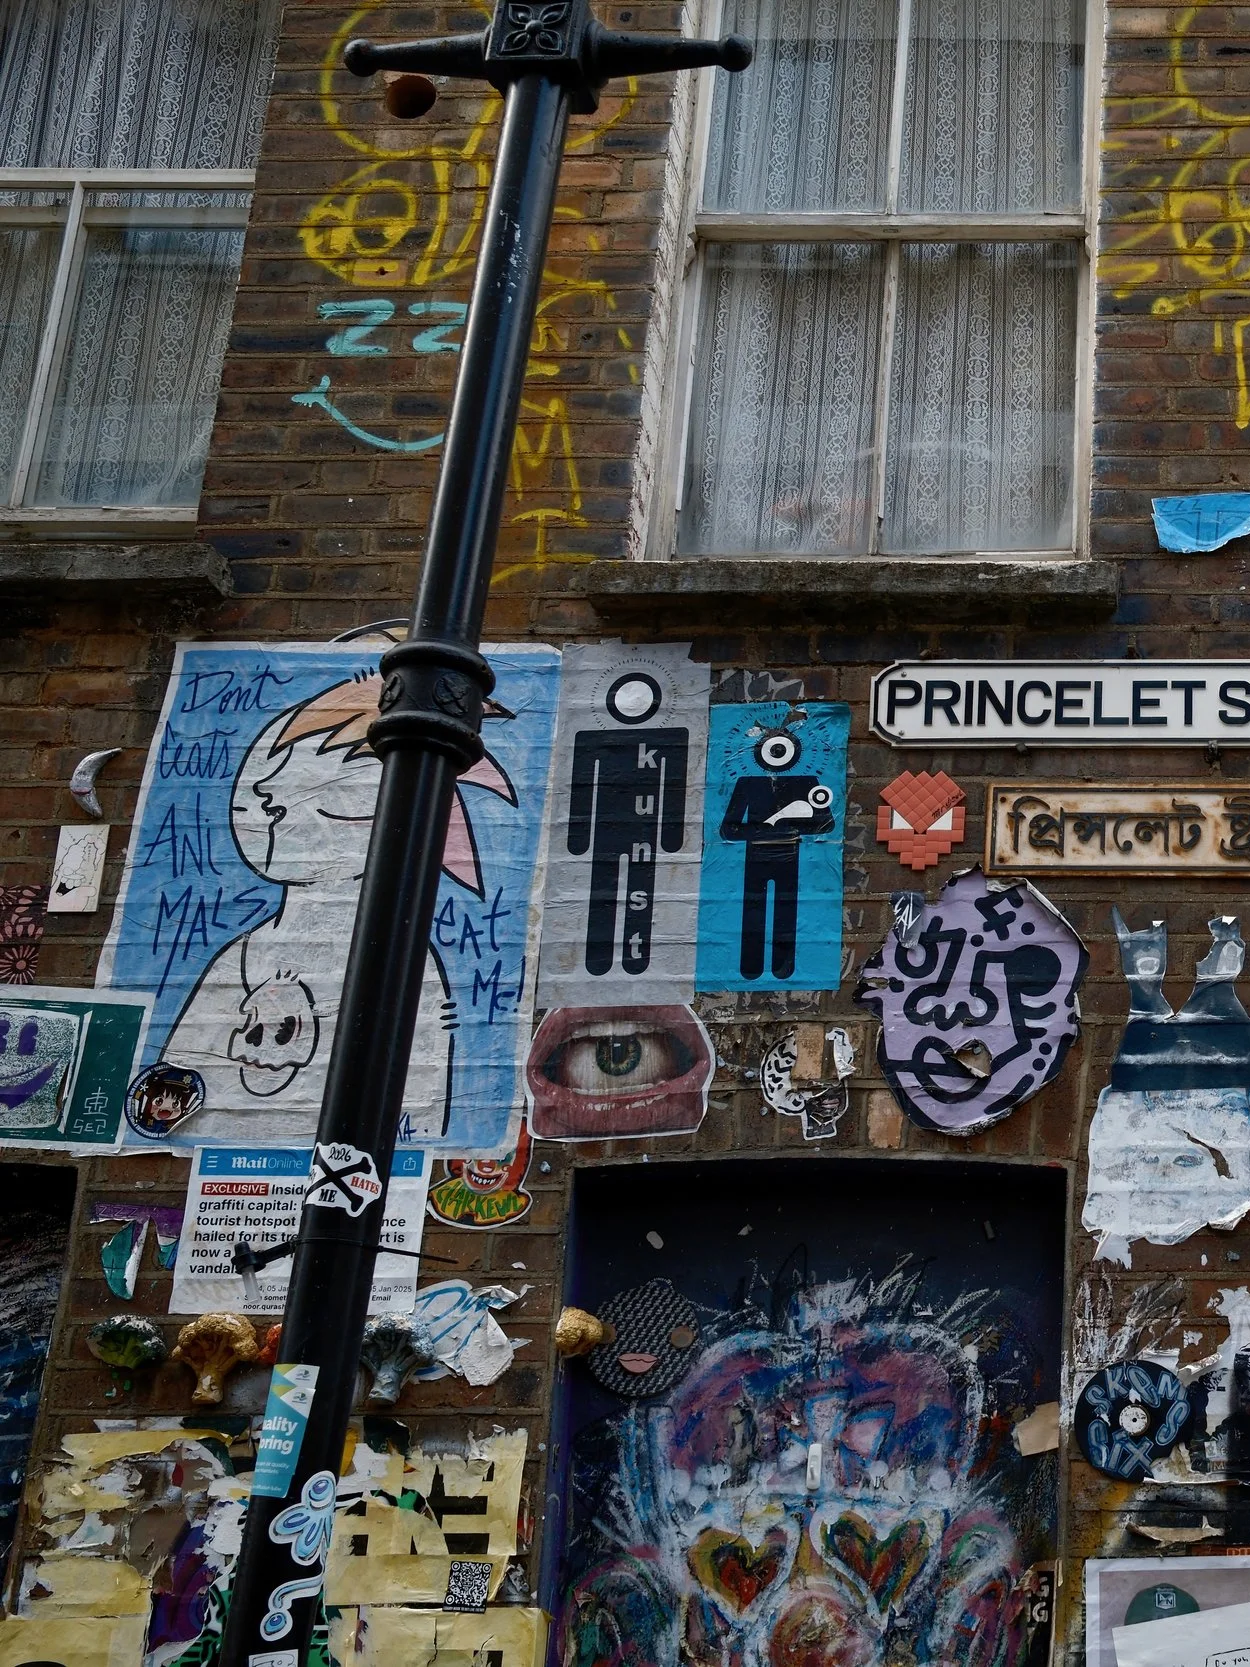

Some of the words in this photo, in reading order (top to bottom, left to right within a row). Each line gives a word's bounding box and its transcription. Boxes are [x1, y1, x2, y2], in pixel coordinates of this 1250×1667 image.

[887, 679, 1205, 727] PRINCELET
[328, 1146, 351, 1162] 2026
[204, 1184, 267, 1195] EXCLUSIVE
[350, 1176, 380, 1195] HATES
[318, 1188, 337, 1203] ME
[199, 1200, 244, 1214] graffiti
[248, 1200, 297, 1214] capital:
[196, 1216, 241, 1226] tourist
[245, 1215, 296, 1230] hotspot
[194, 1231, 236, 1242] hailed
[239, 1231, 258, 1242] for
[261, 1231, 277, 1242] its
[394, 1232, 405, 1242] is
[191, 1248, 220, 1257] now
[223, 1248, 231, 1257] a
